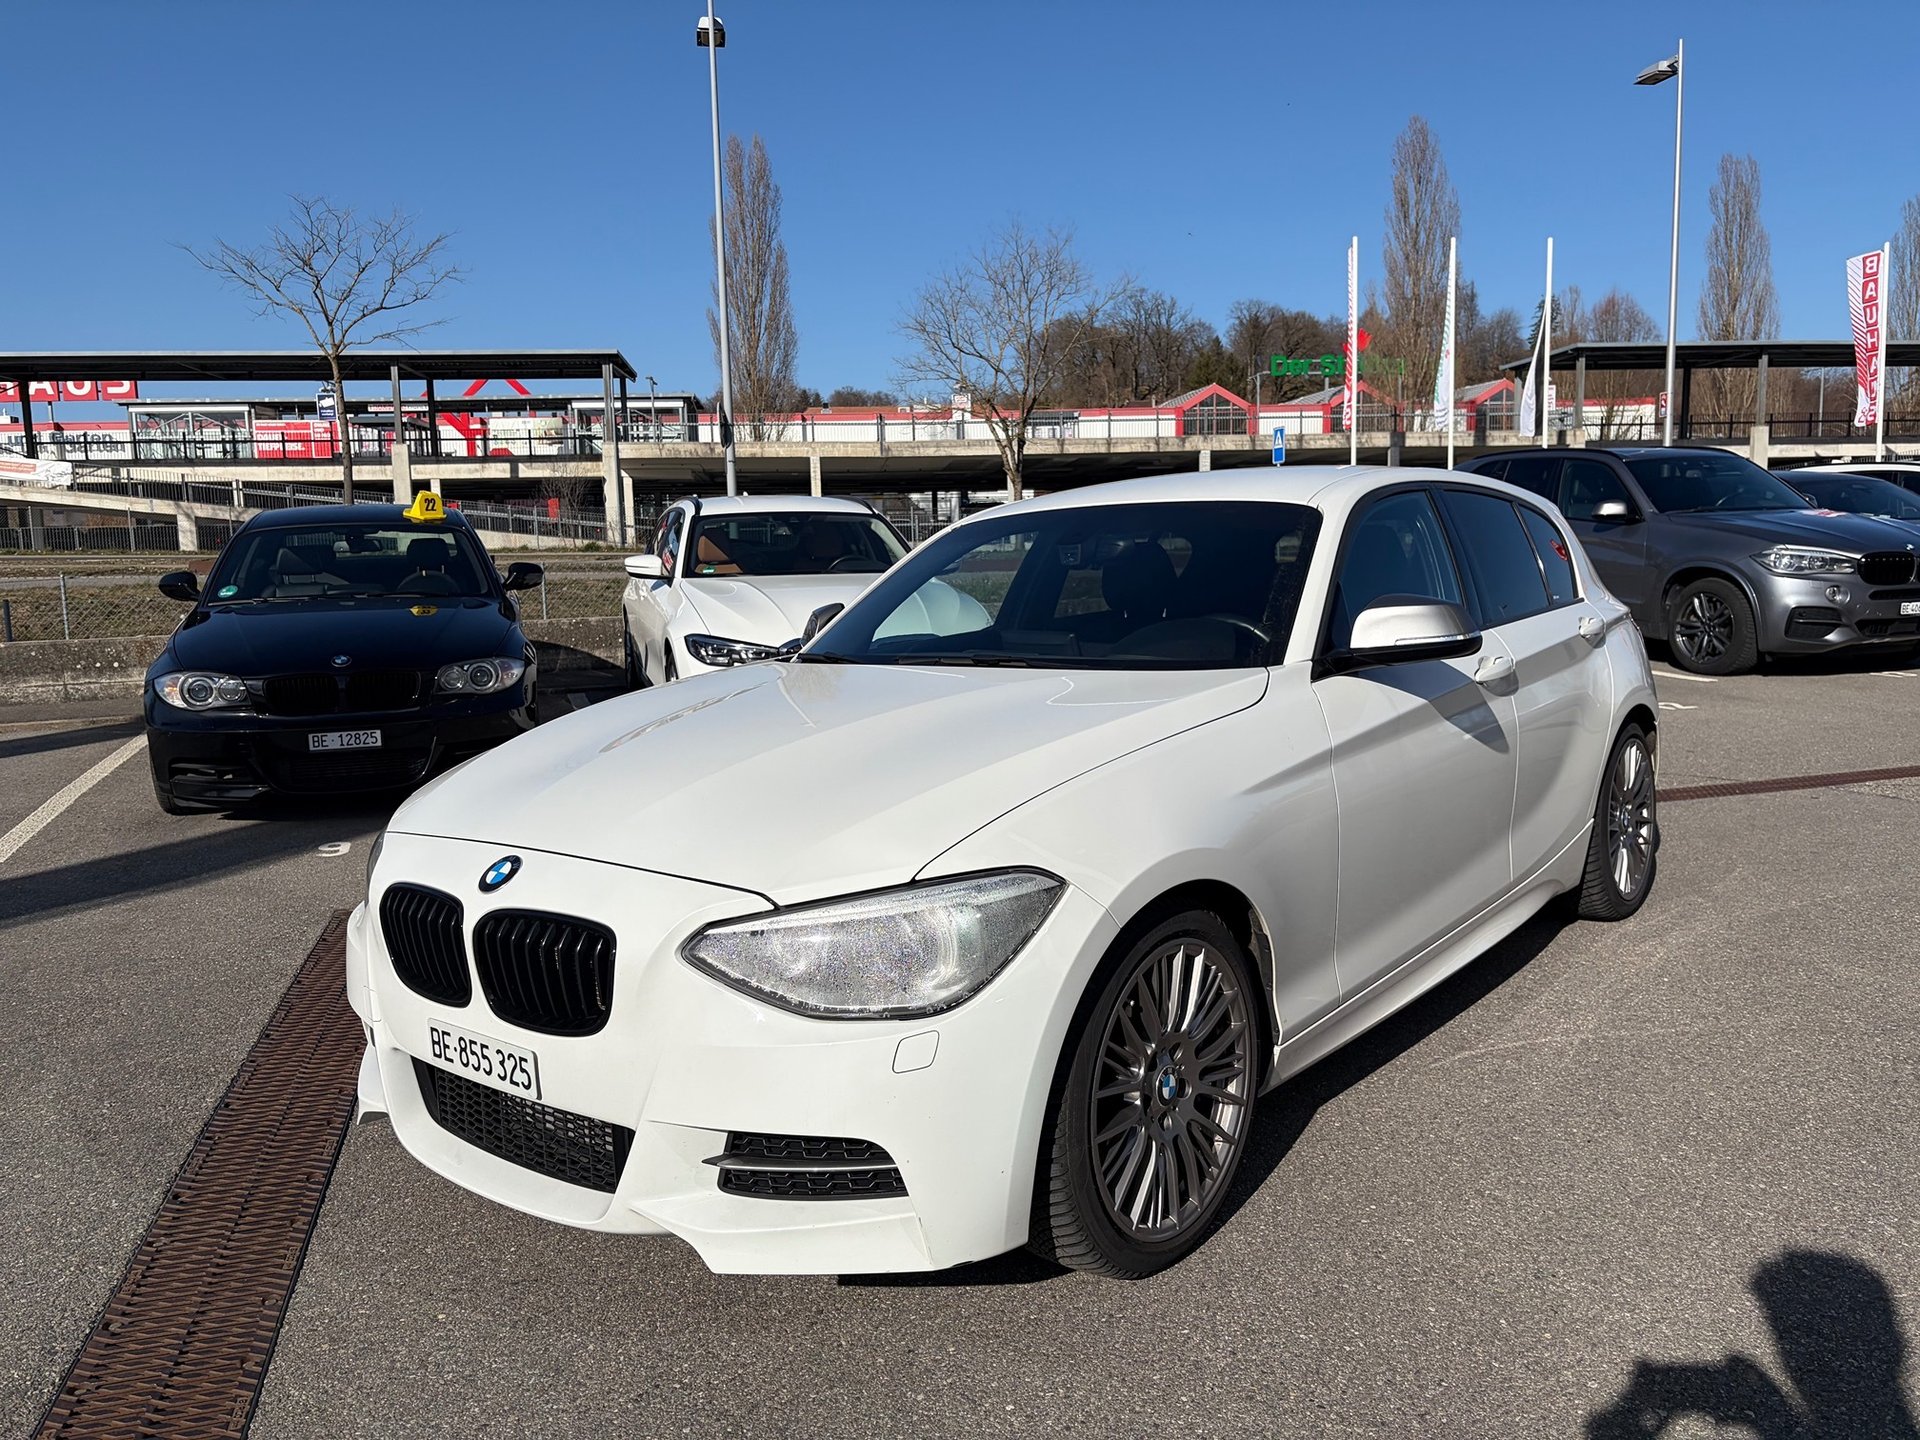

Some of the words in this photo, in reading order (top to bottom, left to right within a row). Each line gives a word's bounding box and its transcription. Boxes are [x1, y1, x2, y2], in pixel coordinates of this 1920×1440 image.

[1271, 355, 1313, 377] Der
[424, 498, 437, 512] 22
[495, 1049, 532, 1091] 325
